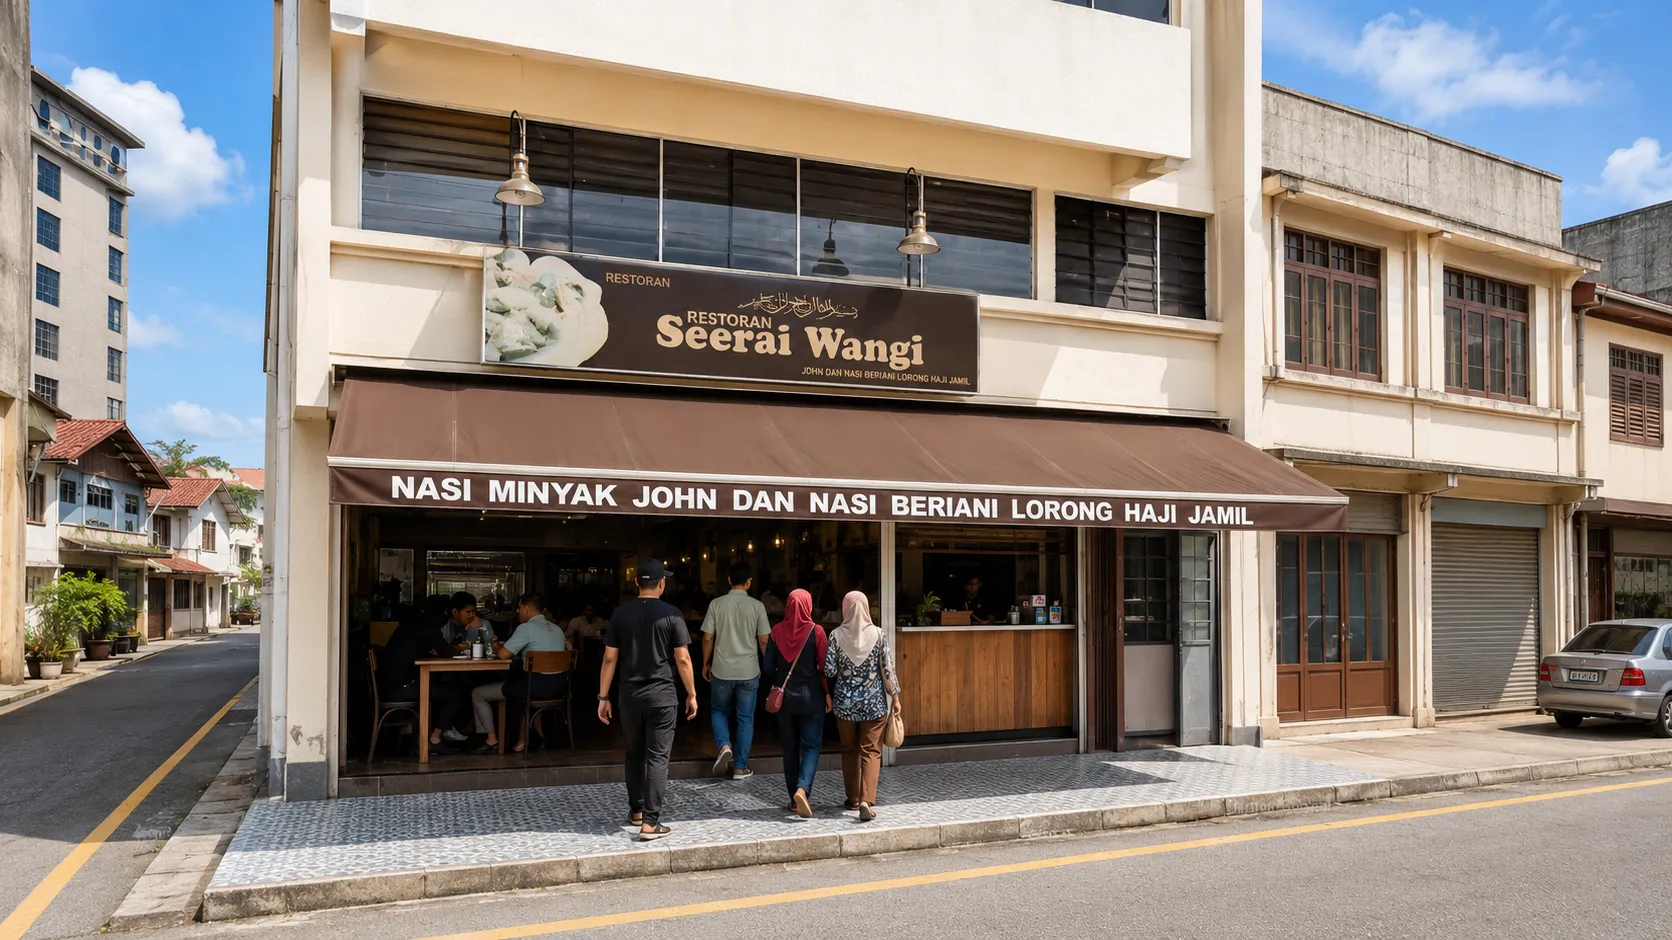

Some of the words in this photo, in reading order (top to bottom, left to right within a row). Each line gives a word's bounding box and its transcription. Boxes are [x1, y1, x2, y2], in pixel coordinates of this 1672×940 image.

[605, 273, 670, 288] RESTORAN
[687, 311, 772, 329] RESTORAN
[656, 314, 793, 356] Seerai
[804, 326, 925, 370] Wangi
[802, 366, 824, 376] JOHN
[825, 368, 842, 377] DAN
[844, 369, 862, 379] NASI
[897, 373, 929, 383] LORONG
[391, 475, 471, 502] NASI
[489, 480, 618, 507] MINYAK
[632, 486, 717, 510] JOHN
[733, 490, 794, 512] DAN
[809, 492, 876, 515] NASI
[891, 495, 998, 519] BERIANI
[1011, 498, 1113, 522] LORONG
[1124, 502, 1177, 524] HAJI
[1187, 505, 1254, 526] JAMIL
